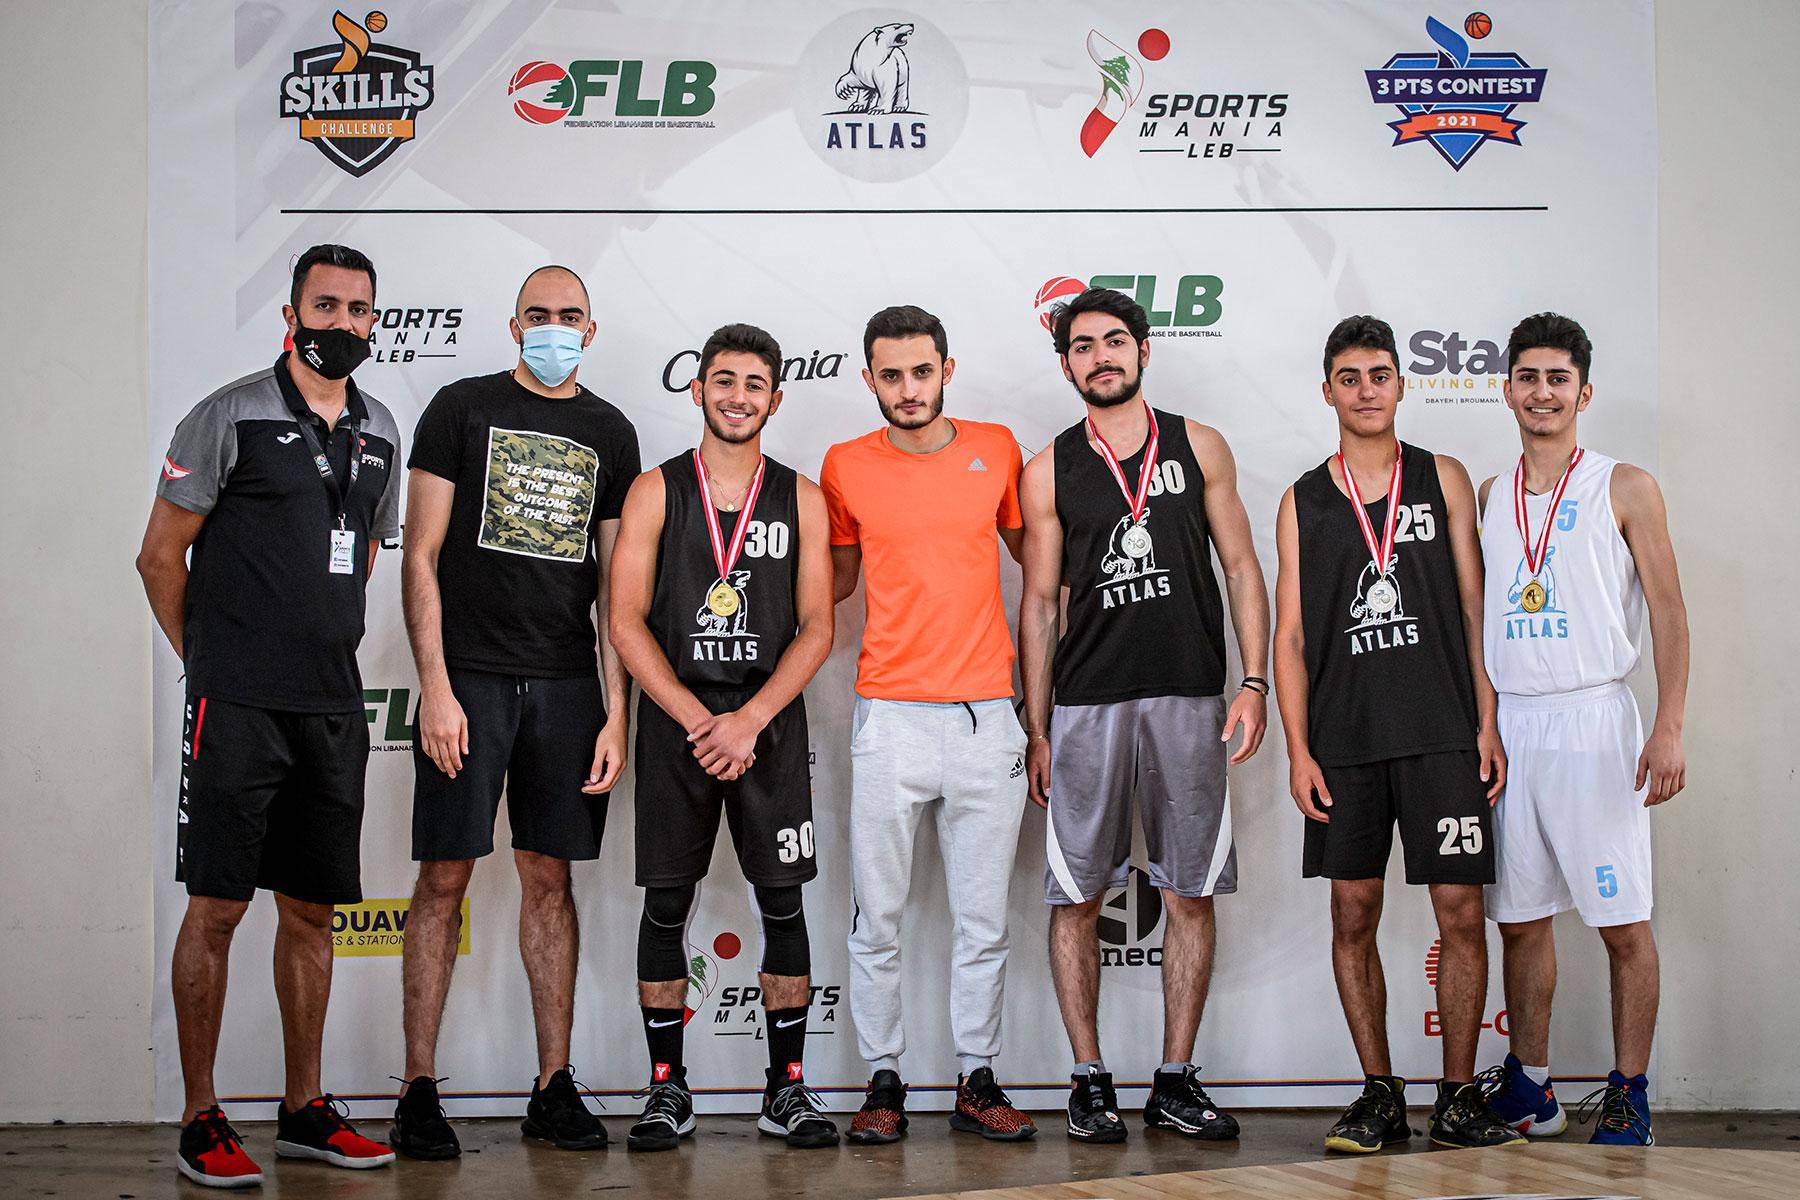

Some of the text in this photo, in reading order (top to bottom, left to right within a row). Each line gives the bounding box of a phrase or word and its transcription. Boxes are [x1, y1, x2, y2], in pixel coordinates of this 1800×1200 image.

[284, 70, 430, 113] SKILLS
[566, 60, 718, 117] FLB
[1377, 77, 1536, 95] 3 PTS CONTEST
[1145, 94, 1289, 118] SPORTS
[321, 122, 393, 135] CHALLENGE
[563, 120, 716, 129] FEDERATION LIBANAISE DE BASKETBALL
[1139, 121, 1282, 137] MANIA
[1436, 116, 1478, 127] 2021
[827, 122, 926, 149] ATLAS
[1187, 143, 1234, 158] LEB
[368, 331, 457, 345] ANIA
[376, 350, 416, 363] LEB
[1407, 378, 1474, 389] LIVING
[506, 462, 585, 485] THE PRESENT
[507, 477, 581, 498] IS THE BEST
[513, 492, 572, 511] OUTCOME
[503, 505, 576, 525] OF THE PAST
[1393, 503, 1436, 544] 25
[1556, 499, 1578, 532] 5
[744, 520, 790, 559] 30
[1102, 575, 1172, 610] ATLAS
[1351, 623, 1420, 655] ATLAS
[1506, 618, 1569, 640] ATLAS
[692, 640, 758, 662] ATLAS
[776, 820, 815, 864] 30
[1437, 815, 1483, 856] 25
[1595, 864, 1618, 899] 5
[346, 935, 354, 946] &
[719, 985, 841, 1007] SPTS
[714, 1008, 835, 1023] MAA
